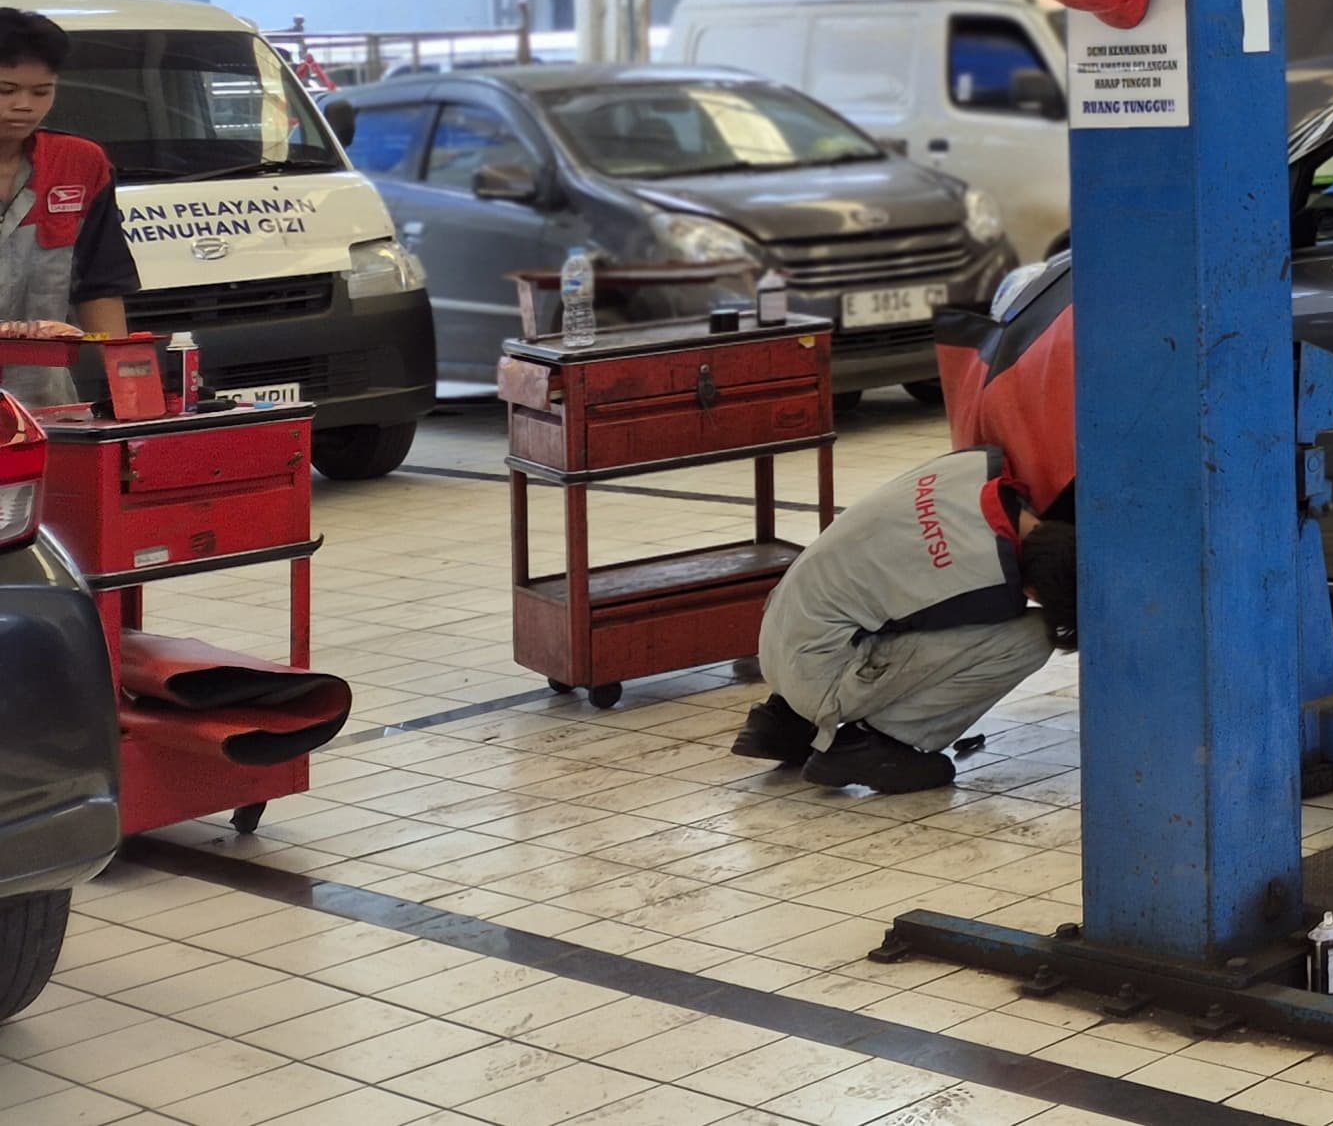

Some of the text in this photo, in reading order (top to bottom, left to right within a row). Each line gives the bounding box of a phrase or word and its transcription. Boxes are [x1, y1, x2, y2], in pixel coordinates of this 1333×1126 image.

[1152, 44, 1167, 55] DAN
[1083, 99, 1176, 114] RUANG TUNGGU!!
[173, 199, 317, 219] PELAYANAN
[257, 217, 305, 234] GIZI
[915, 474, 953, 569] DAIHATSU
